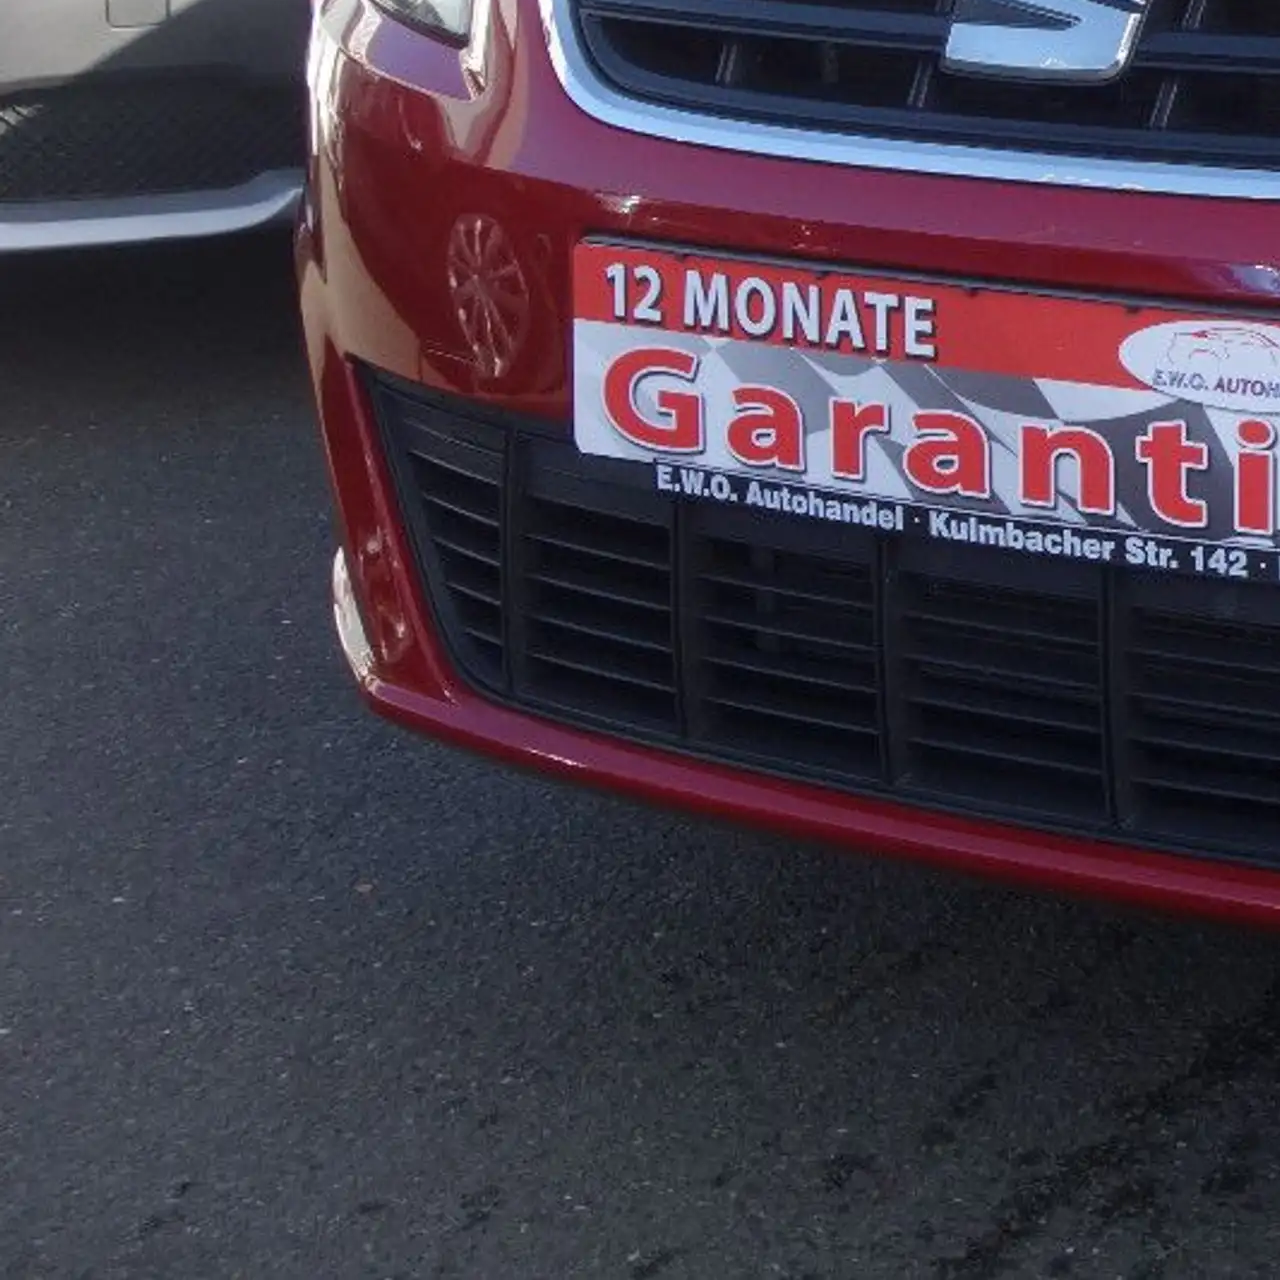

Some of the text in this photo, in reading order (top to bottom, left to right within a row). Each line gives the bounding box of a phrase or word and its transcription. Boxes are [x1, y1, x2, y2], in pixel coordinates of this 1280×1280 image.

[606, 263, 937, 358] 12 MONATE
[1152, 368, 1208, 391] E.W.O.
[656, 465, 738, 503] E.W.O.
[745, 480, 905, 532] Autohandel
[928, 509, 1116, 562] Kulmbacher
[1124, 536, 1180, 570] Str.
[1190, 545, 1249, 579] 142
